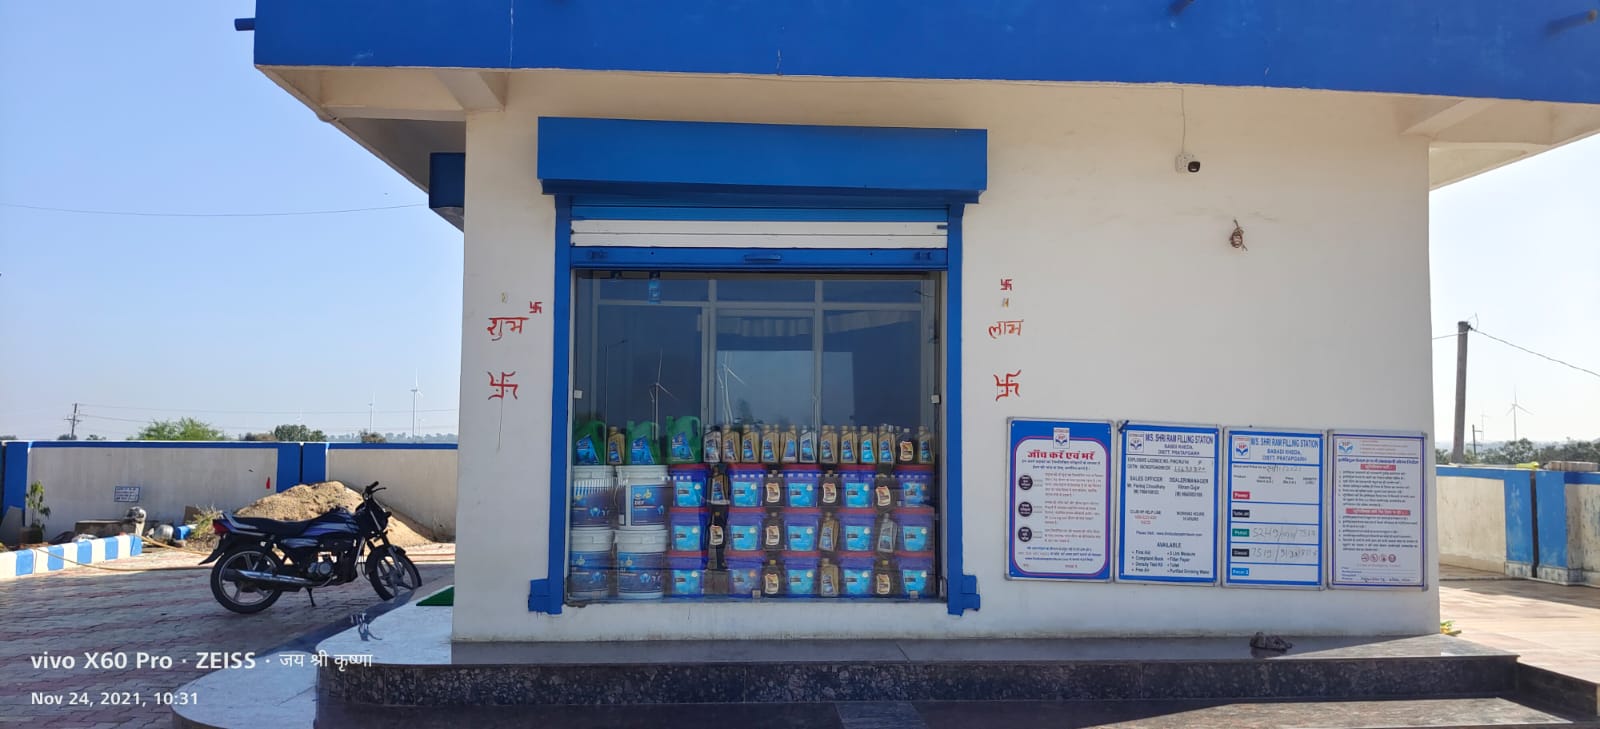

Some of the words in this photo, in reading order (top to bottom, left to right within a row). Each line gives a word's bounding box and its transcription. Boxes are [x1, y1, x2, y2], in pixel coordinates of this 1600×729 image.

[486, 316, 530, 342] शुभ
[988, 319, 1024, 340] लाभ
[1155, 433, 1167, 443] SHRI
[1167, 434, 1177, 443] RAM
[1177, 434, 1194, 443] FILLING
[1195, 435, 1213, 445] STATION
[1272, 438, 1282, 447] RAM
[1282, 439, 1300, 448] FILLING
[1300, 439, 1319, 449] STATION
